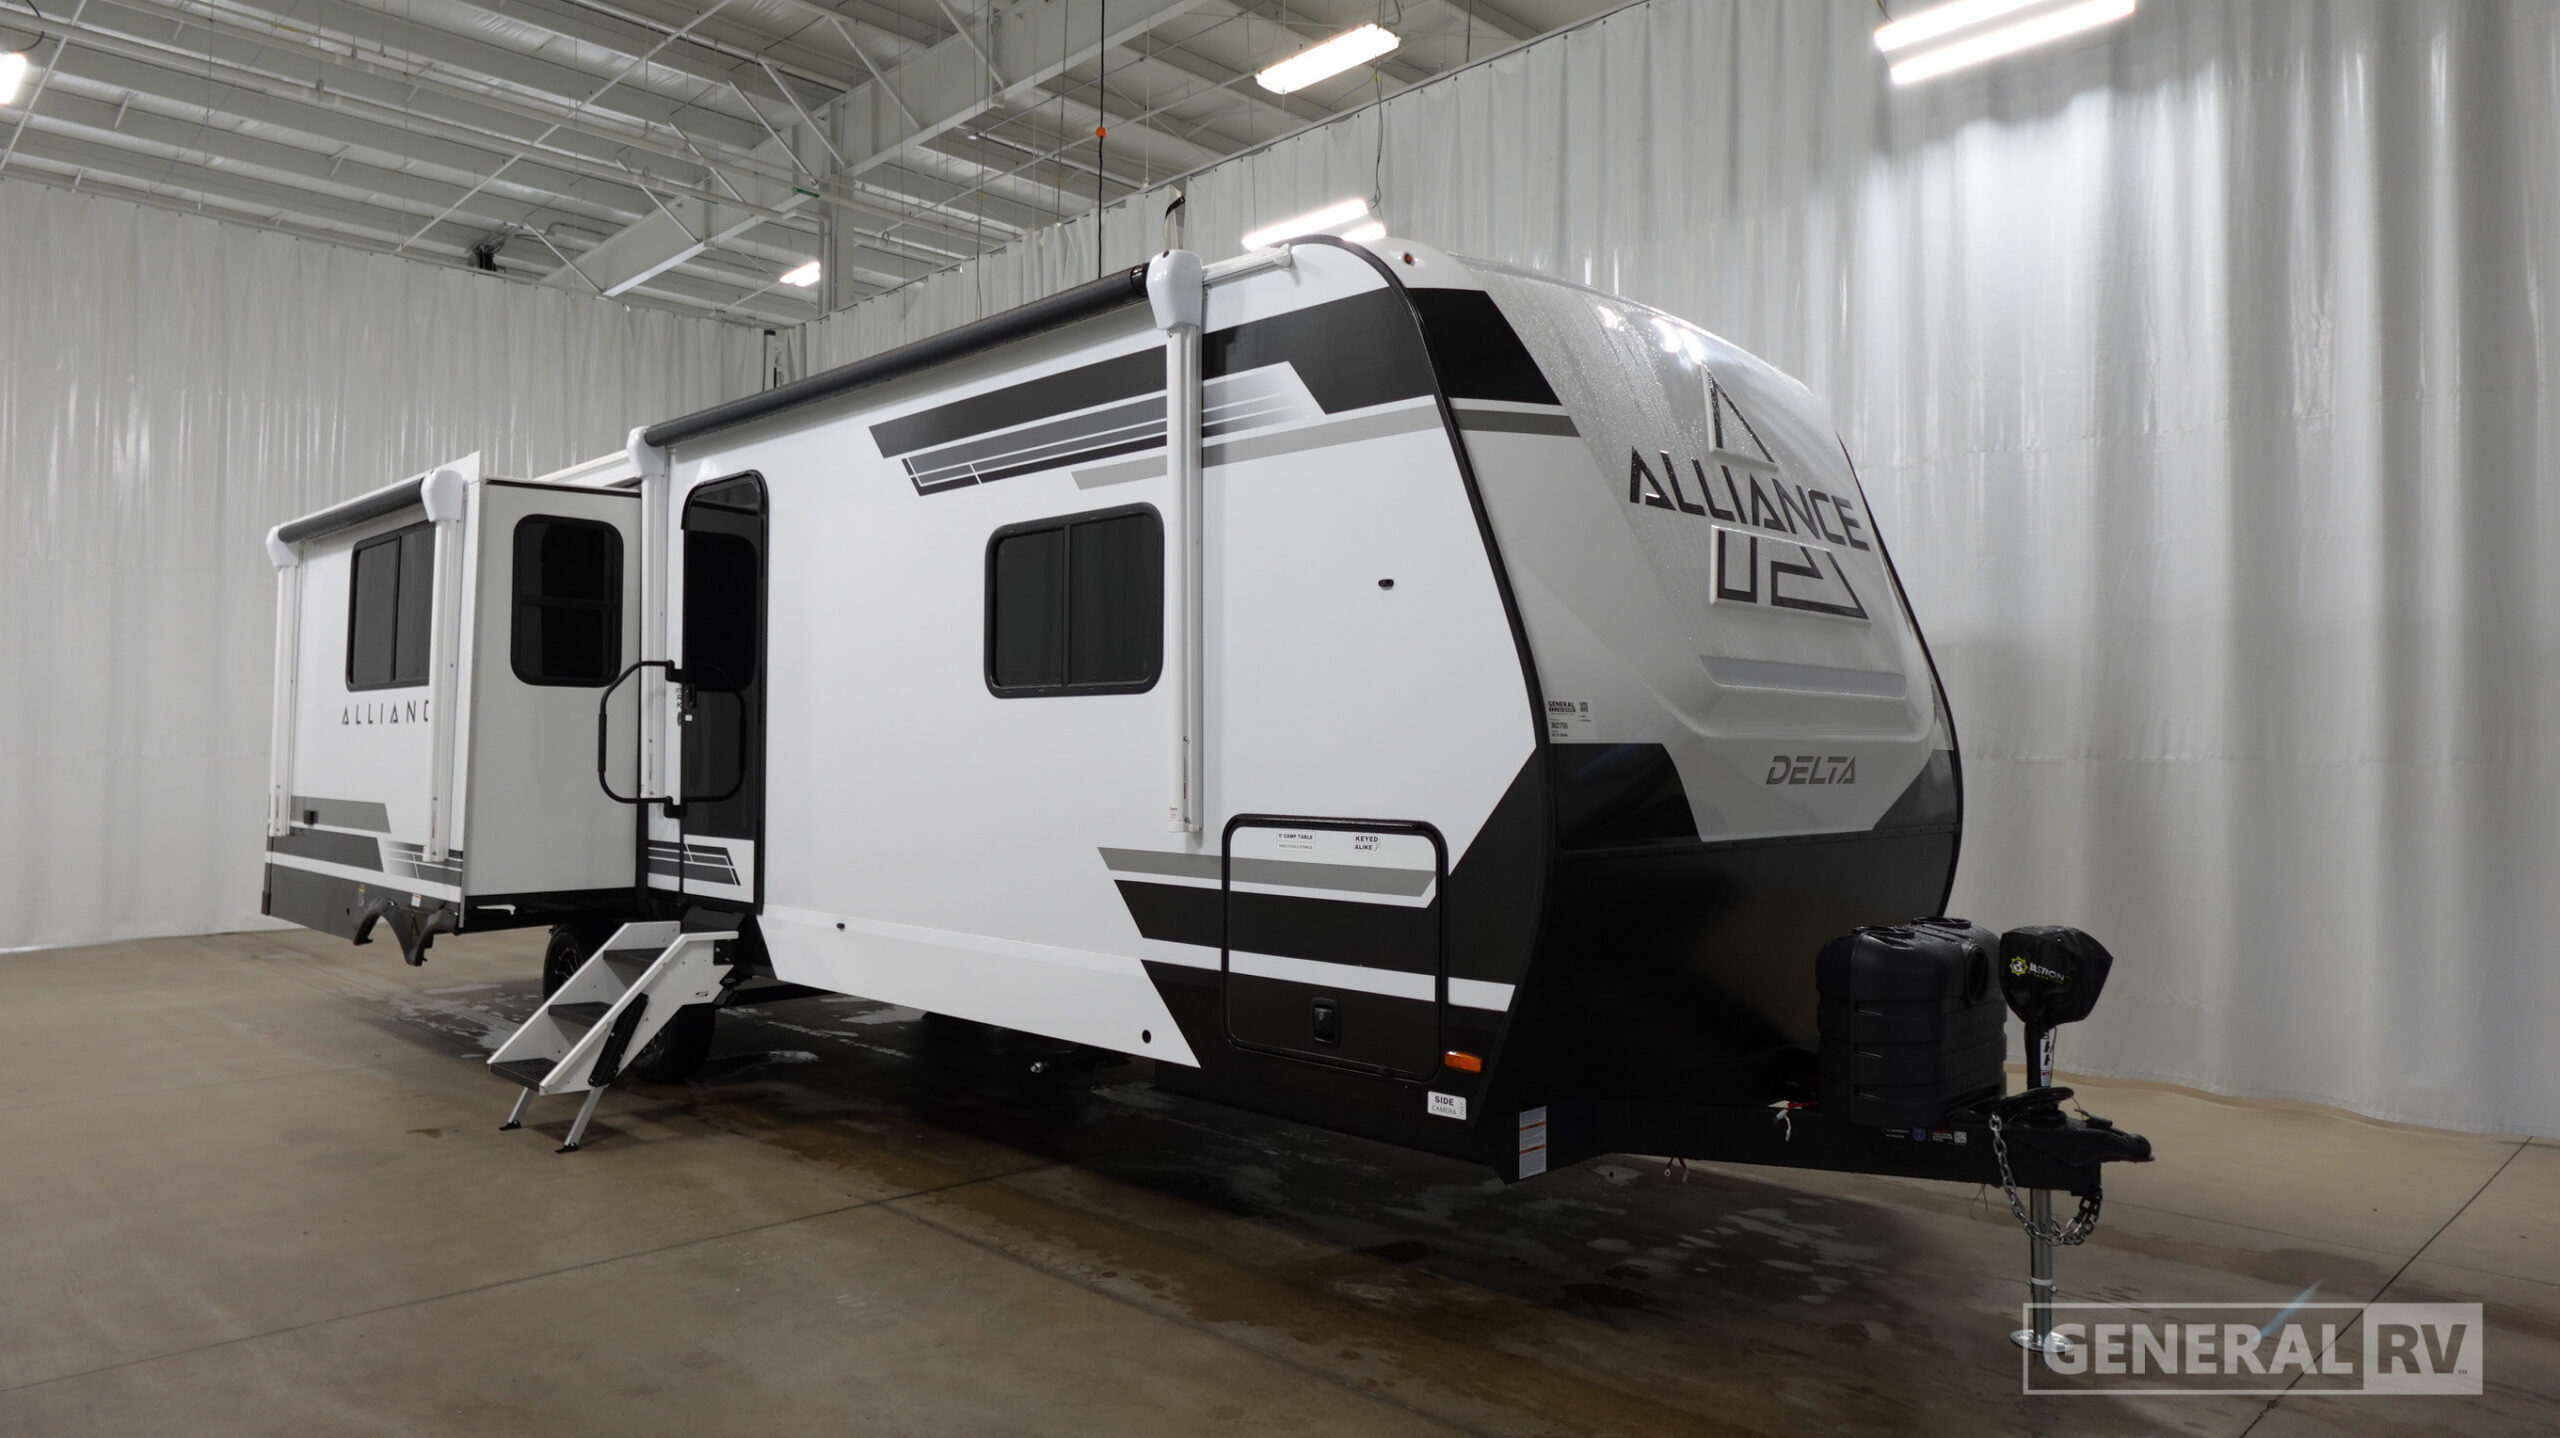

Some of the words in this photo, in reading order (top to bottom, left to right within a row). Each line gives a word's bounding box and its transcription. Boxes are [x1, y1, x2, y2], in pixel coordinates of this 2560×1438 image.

[1629, 446, 1870, 552] ALLIANCE
[342, 699, 429, 725] ALLIANC
[1765, 755, 1856, 785] DELTA
[1355, 835, 1379, 843] KEYED
[1434, 1095, 1454, 1105] SIDE
[1431, 1105, 1457, 1115] CAMERA
